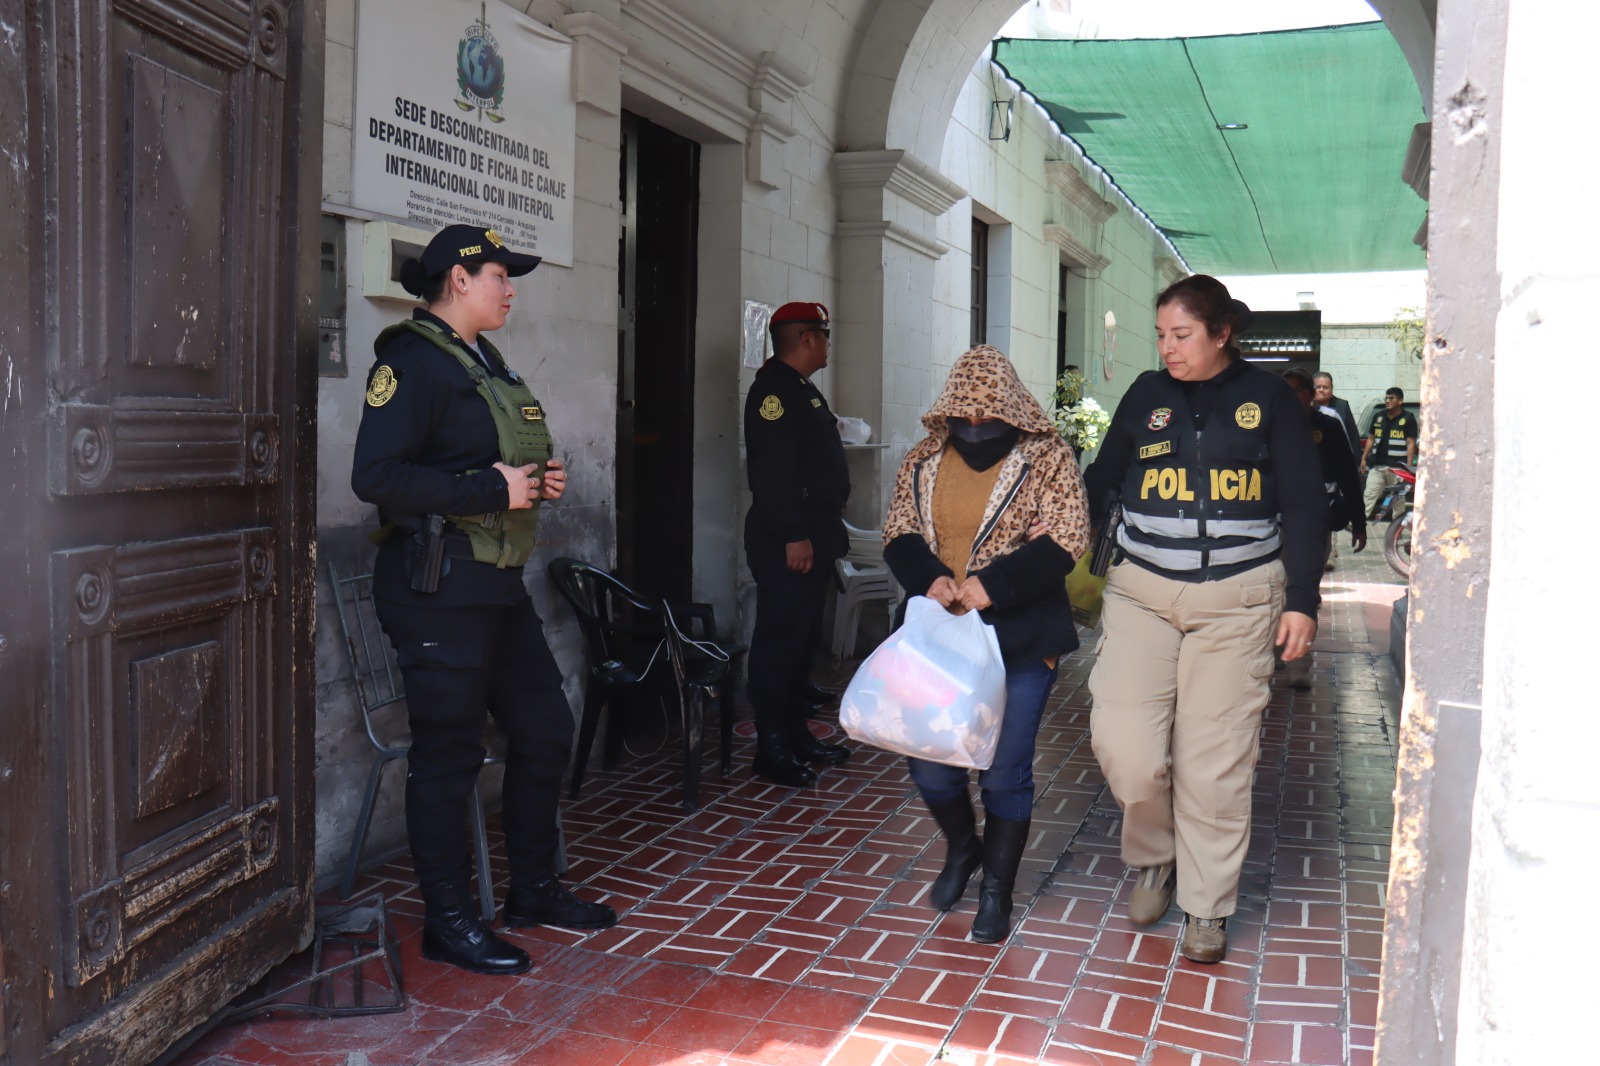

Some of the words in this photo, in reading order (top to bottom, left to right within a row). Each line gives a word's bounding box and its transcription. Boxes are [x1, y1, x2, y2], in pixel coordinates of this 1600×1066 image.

[466, 89, 494, 106] INTERPOL
[395, 96, 426, 126] SEDE
[430, 110, 530, 163] DESCONCENTRADA
[532, 148, 550, 169] DEL
[369, 117, 466, 168] DEPARTAMENTO
[470, 152, 484, 174] DE
[488, 158, 518, 185] FICHA
[522, 170, 534, 190] DE
[536, 174, 566, 200] CANJE
[385, 153, 480, 200] INTERNACIONAL
[483, 183, 505, 207] OCN
[508, 190, 554, 221] INTERPOL
[406, 200, 426, 212] Horario
[426, 206, 433, 214] de
[433, 208, 456, 220] atención:
[456, 214, 471, 224] Lunes
[475, 218, 492, 230] Viernes
[409, 190, 436, 204] Dirección:
[436, 198, 449, 208] Calle
[449, 201, 459, 211] San
[459, 204, 482, 217] Francisco
[488, 212, 496, 220] 214
[496, 214, 515, 226] Cercado
[518, 221, 536, 232] Arequipa
[432, 218, 444, 227] Web
[459, 245, 482, 257] PERU
